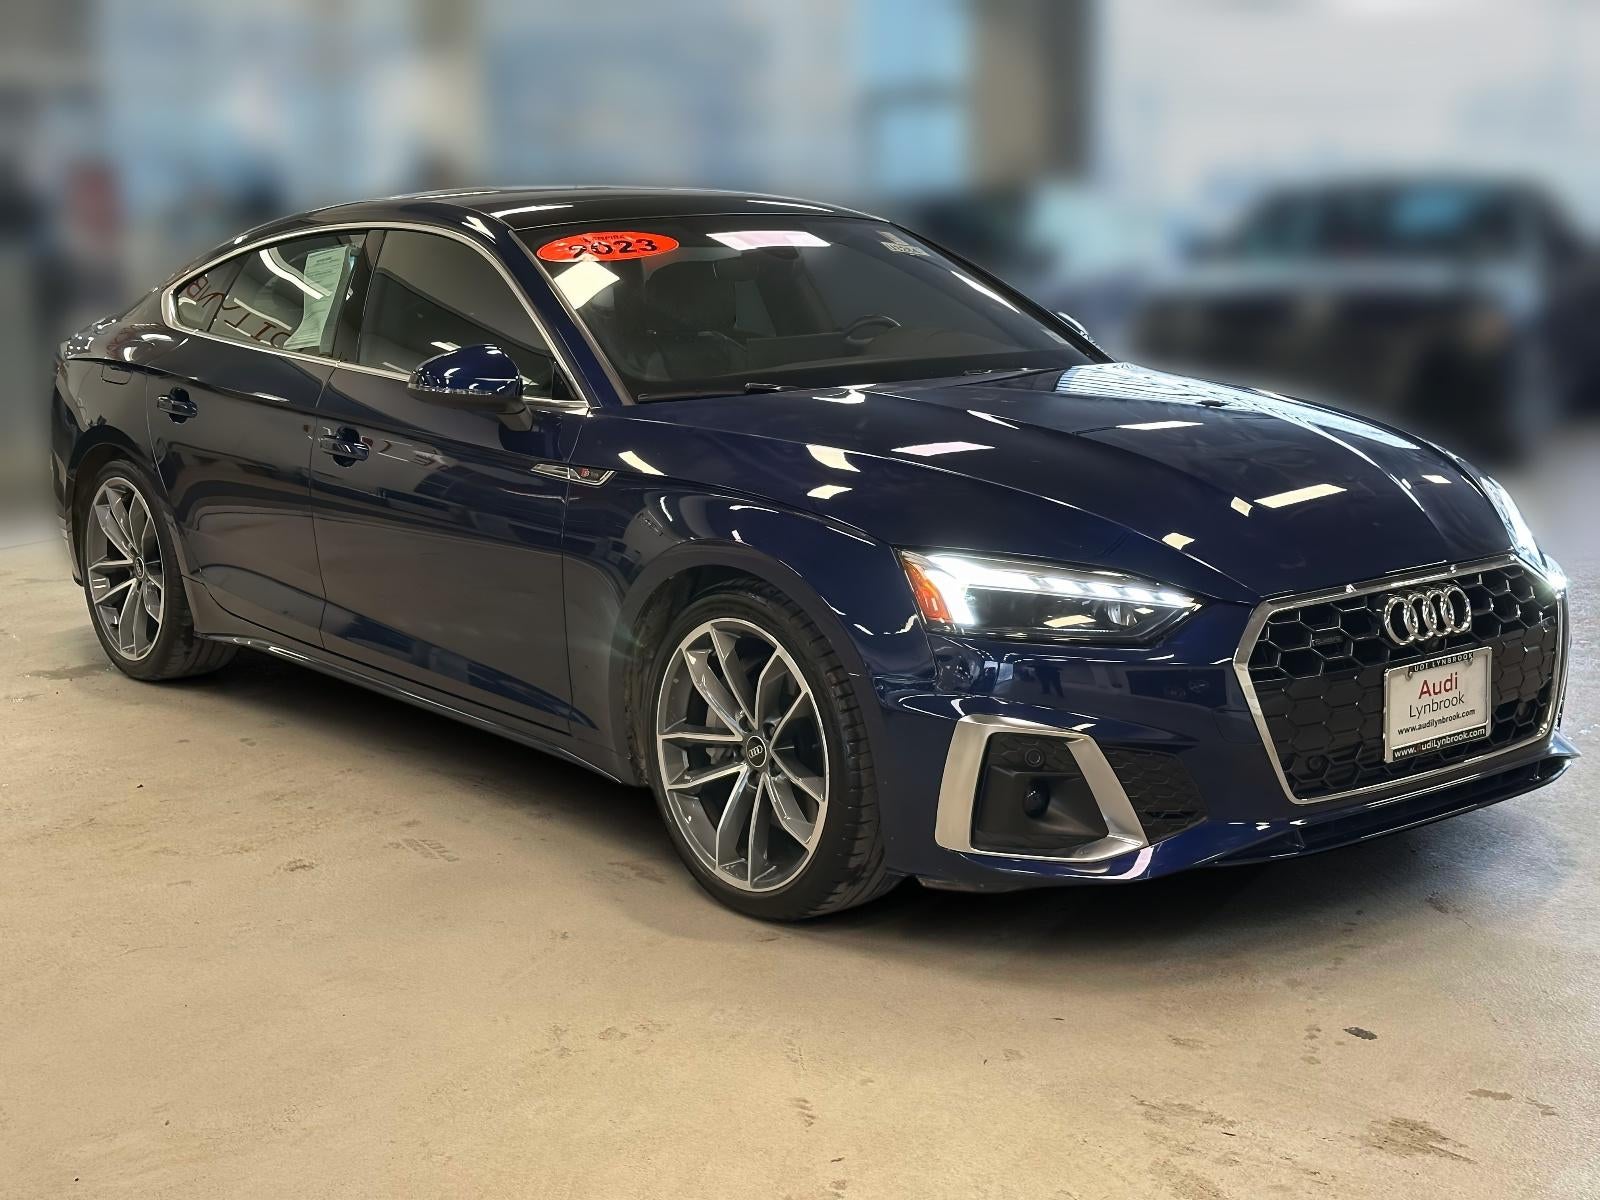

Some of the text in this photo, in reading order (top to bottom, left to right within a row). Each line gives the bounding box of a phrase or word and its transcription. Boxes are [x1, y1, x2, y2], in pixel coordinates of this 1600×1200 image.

[1418, 672, 1458, 699] Audi
[1409, 691, 1465, 719] Lynbrook
[1397, 709, 1476, 735] www.audilynbrook.com
